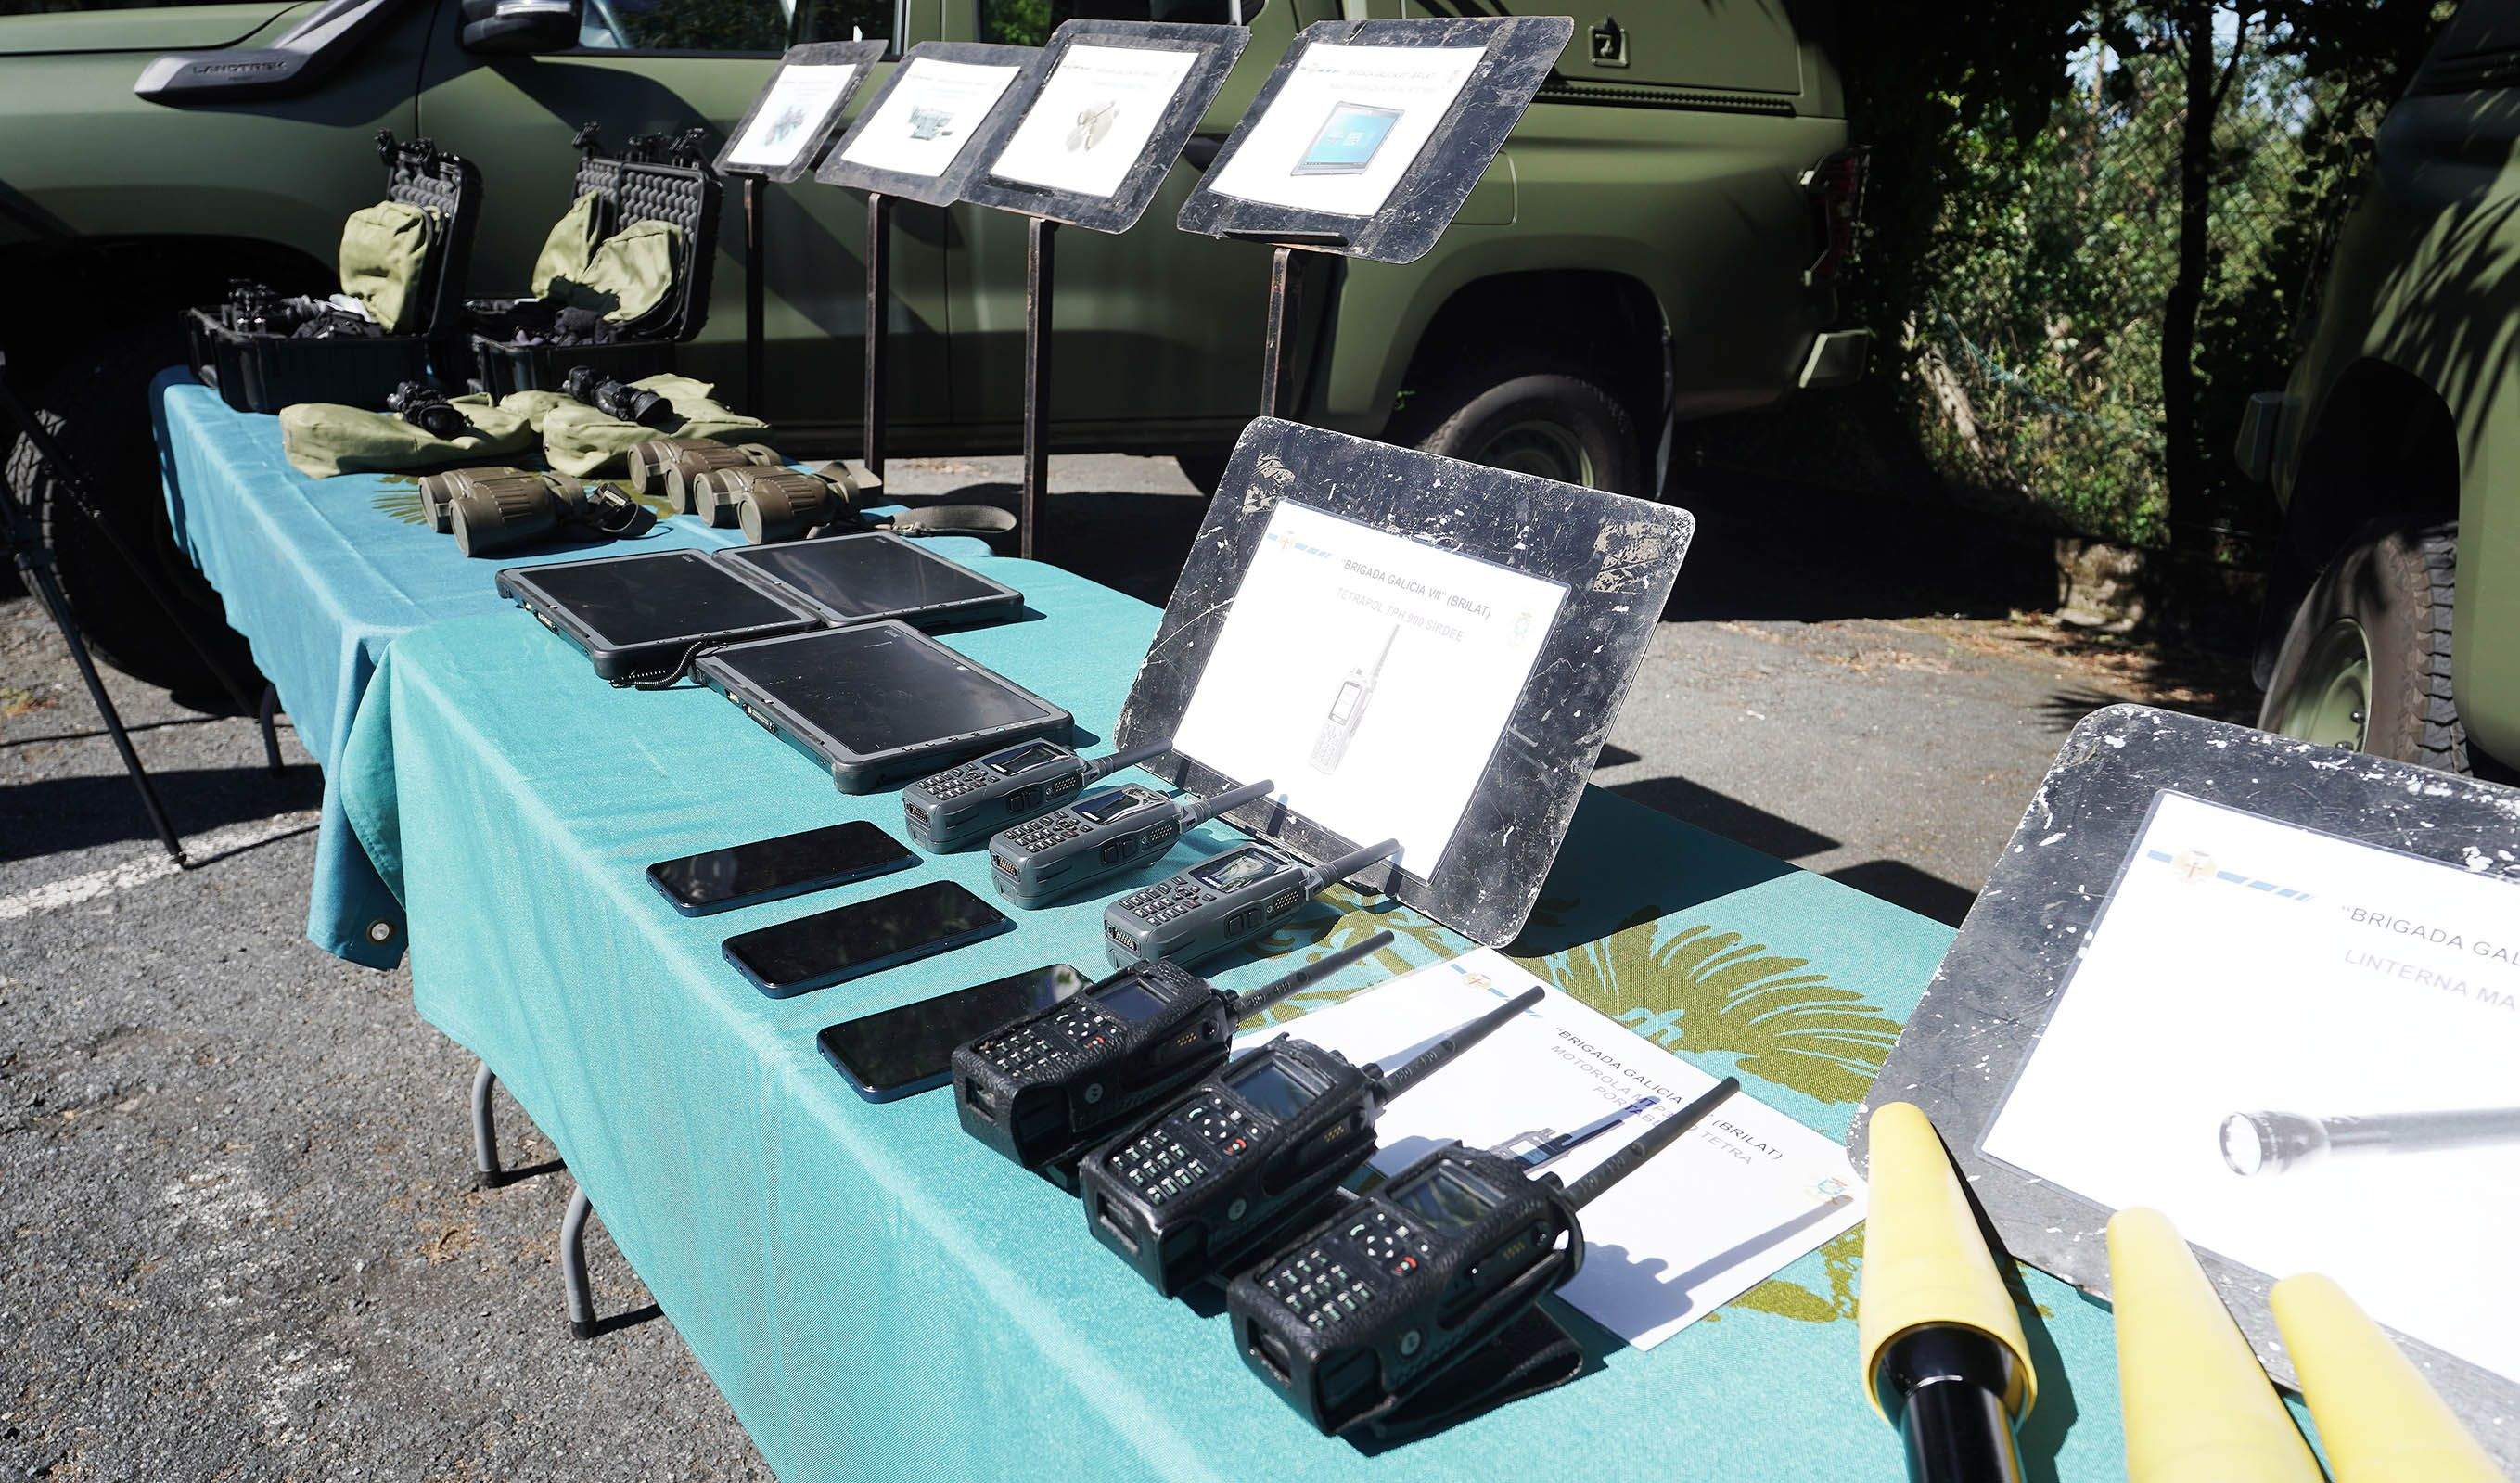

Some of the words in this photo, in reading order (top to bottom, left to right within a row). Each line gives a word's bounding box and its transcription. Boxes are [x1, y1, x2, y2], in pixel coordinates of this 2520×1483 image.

[1337, 587, 1383, 613] TETRAPOL
[1426, 619, 1465, 642] SIRDEE
[1387, 574, 1426, 595] GALICIA
[1447, 594, 1490, 620] (BRILAT)
[2341, 905, 2463, 950] “BRIGADA
[2344, 949, 2468, 996] LINTERNA
[1551, 1045, 1631, 1095] MOTOROLA
[1701, 1131, 1752, 1165] TETRA
[1623, 1068, 1682, 1105] GALICIA
[1712, 1119, 1783, 1160] (BRILAT)
